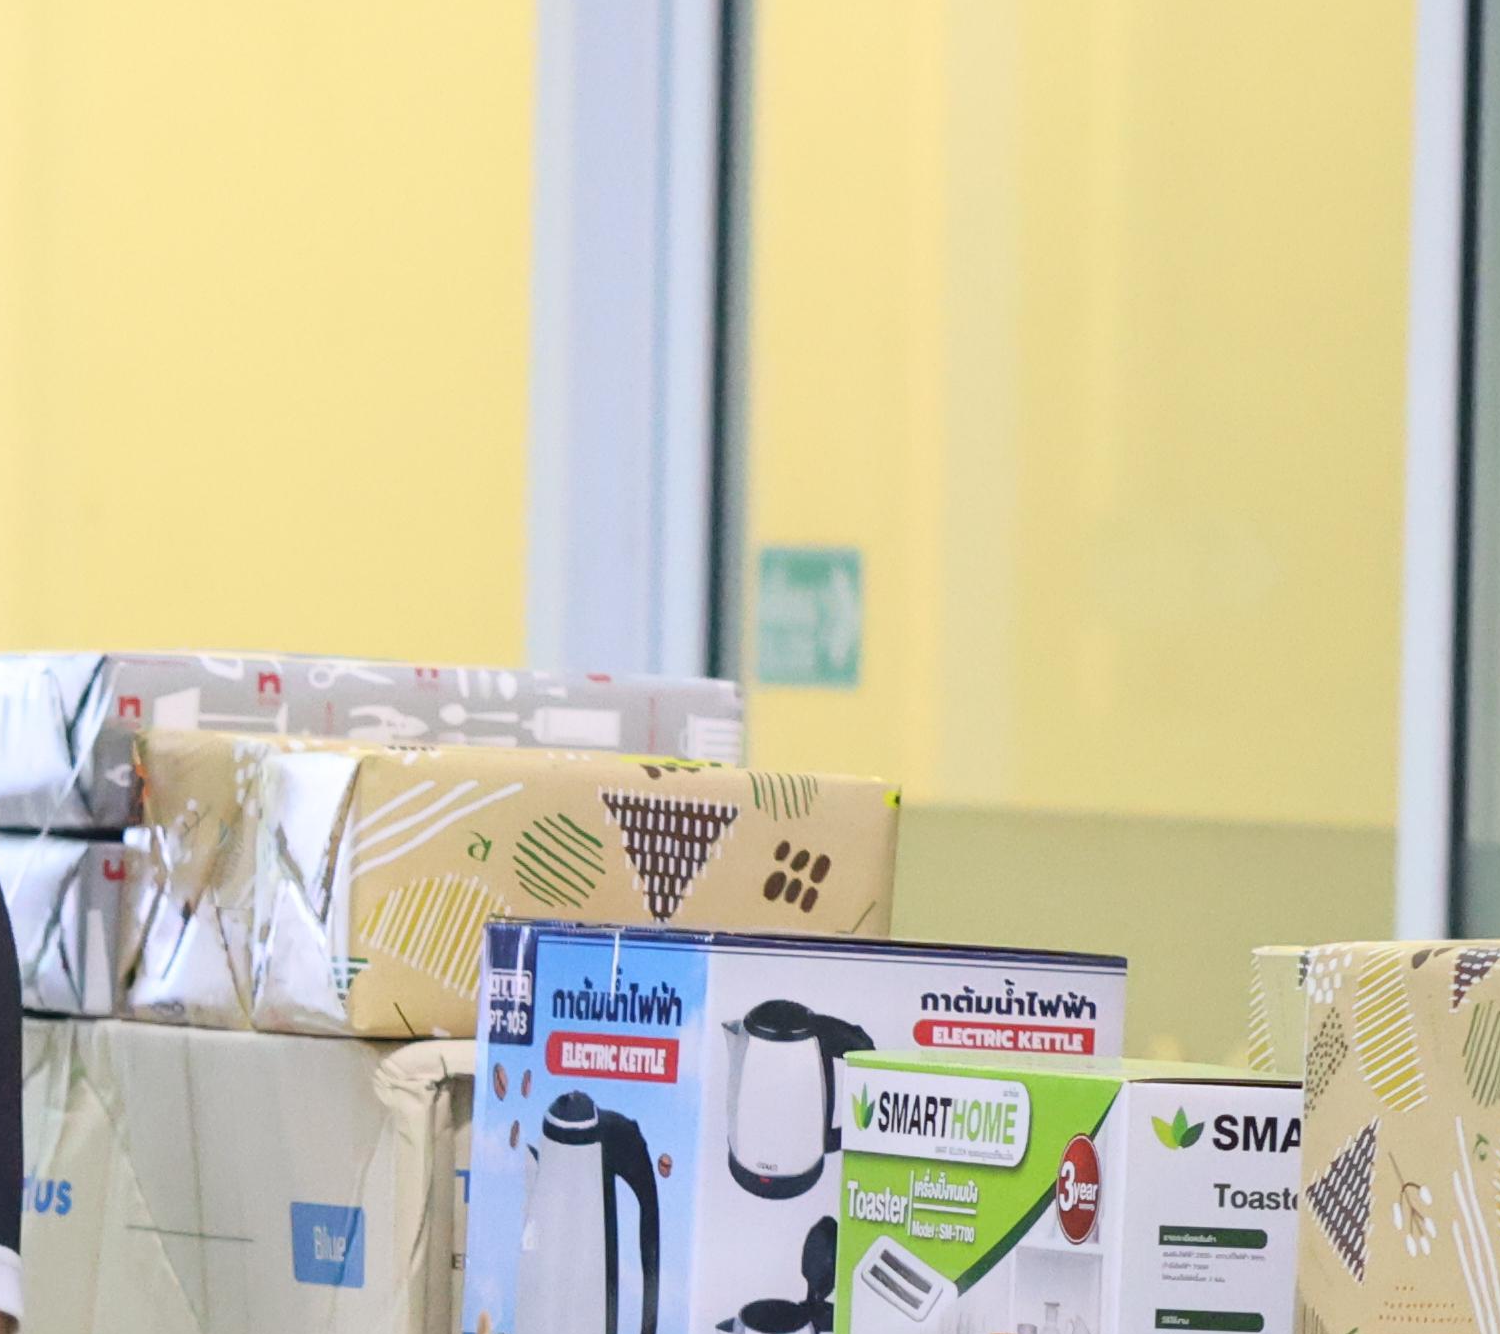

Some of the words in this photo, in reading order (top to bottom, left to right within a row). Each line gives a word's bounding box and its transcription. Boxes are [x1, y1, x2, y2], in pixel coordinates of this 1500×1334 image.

[920, 978, 1097, 1020] กาต้มน้ำไฟฟ้า
[561, 1041, 618, 1070] ELECTRIC
[618, 1045, 667, 1075] KETTLE
[931, 1025, 1014, 1048] ELECTRIC
[1017, 1032, 1084, 1053] KETTLE
[877, 1090, 1019, 1146] SMARTHOME
[1212, 1113, 1302, 1154] SMA
[847, 1180, 909, 1224] Toaster
[1058, 1160, 1076, 1212] 3
[1073, 1181, 1099, 1205] year
